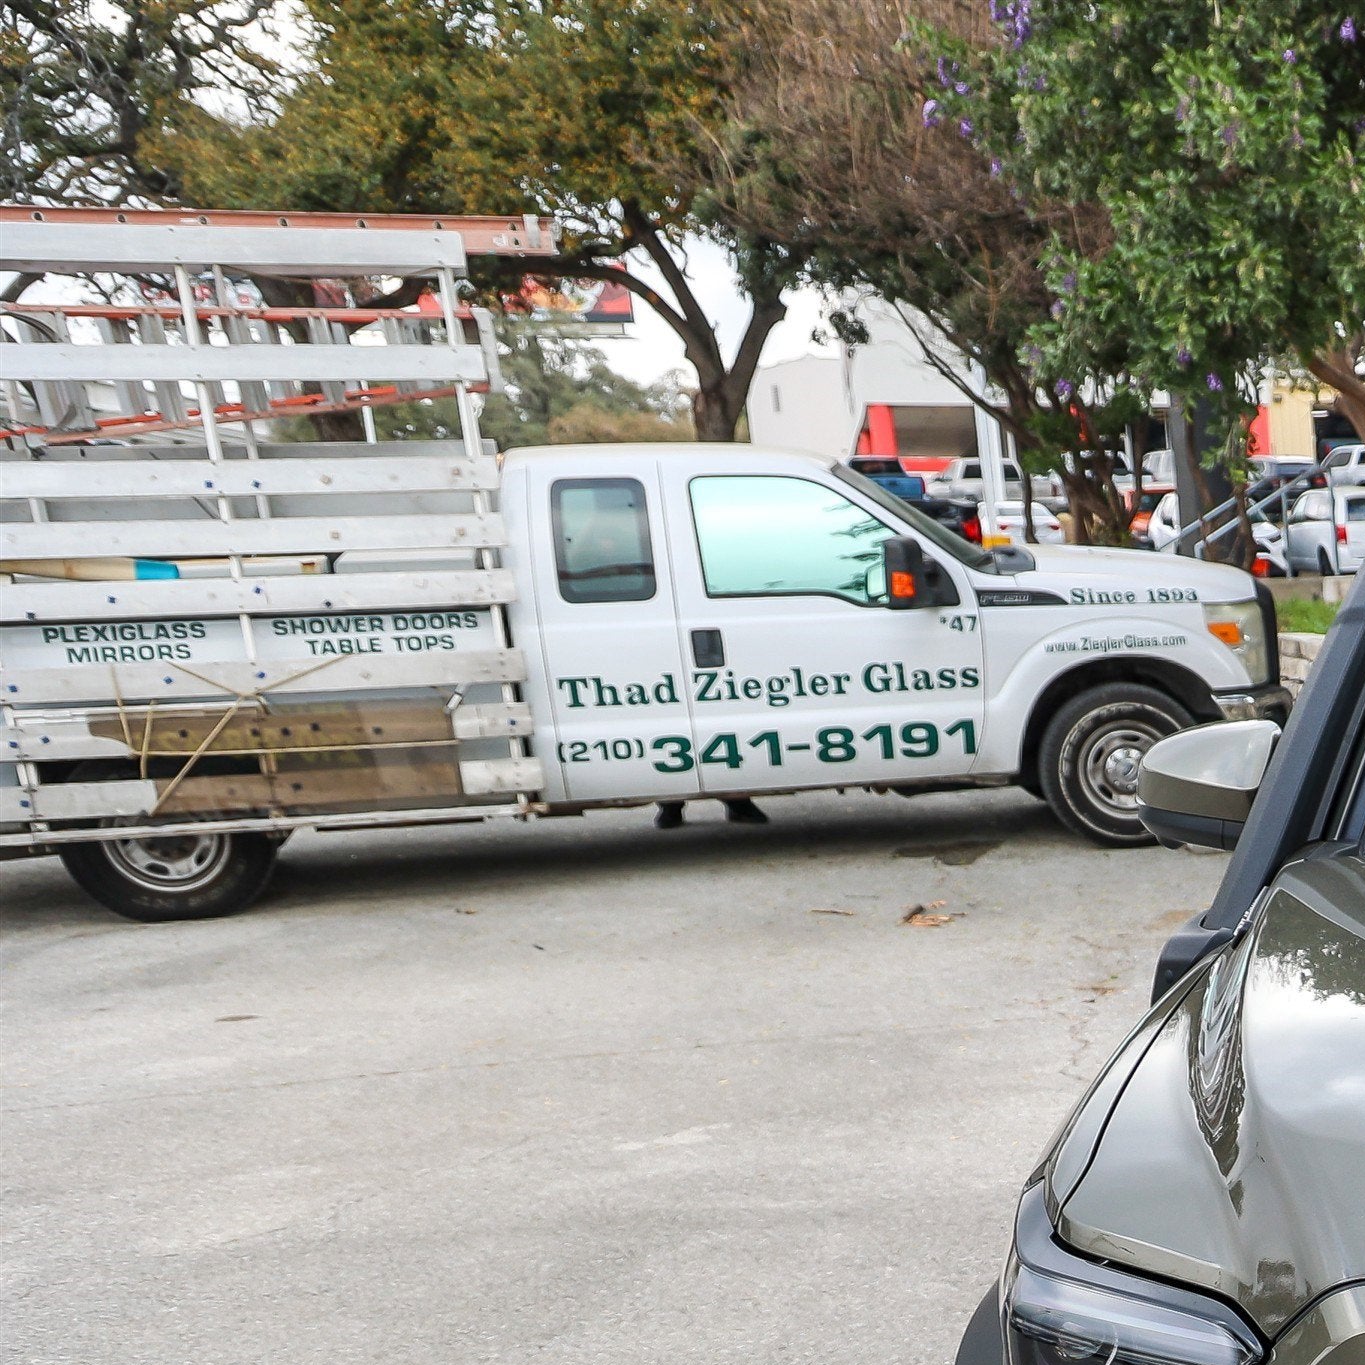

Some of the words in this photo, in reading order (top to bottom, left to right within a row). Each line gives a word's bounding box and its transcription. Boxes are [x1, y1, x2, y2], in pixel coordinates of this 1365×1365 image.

[1069, 588, 1135, 605] Since
[1147, 588, 1198, 603] 1893
[41, 622, 206, 643] PLEXIGLASS
[272, 615, 385, 636] SHOWER
[392, 612, 478, 631] DOORS
[66, 644, 191, 663] MIRRORS
[305, 637, 382, 655] TABLE
[391, 635, 455, 651] TOPS
[1044, 634, 1187, 653] www.ZieglerGlass.com
[558, 673, 680, 709] Thad
[692, 666, 851, 707] Ziegler
[861, 661, 980, 693] Glass
[557, 737, 645, 763] (210)
[651, 718, 977, 774] 341-8191
